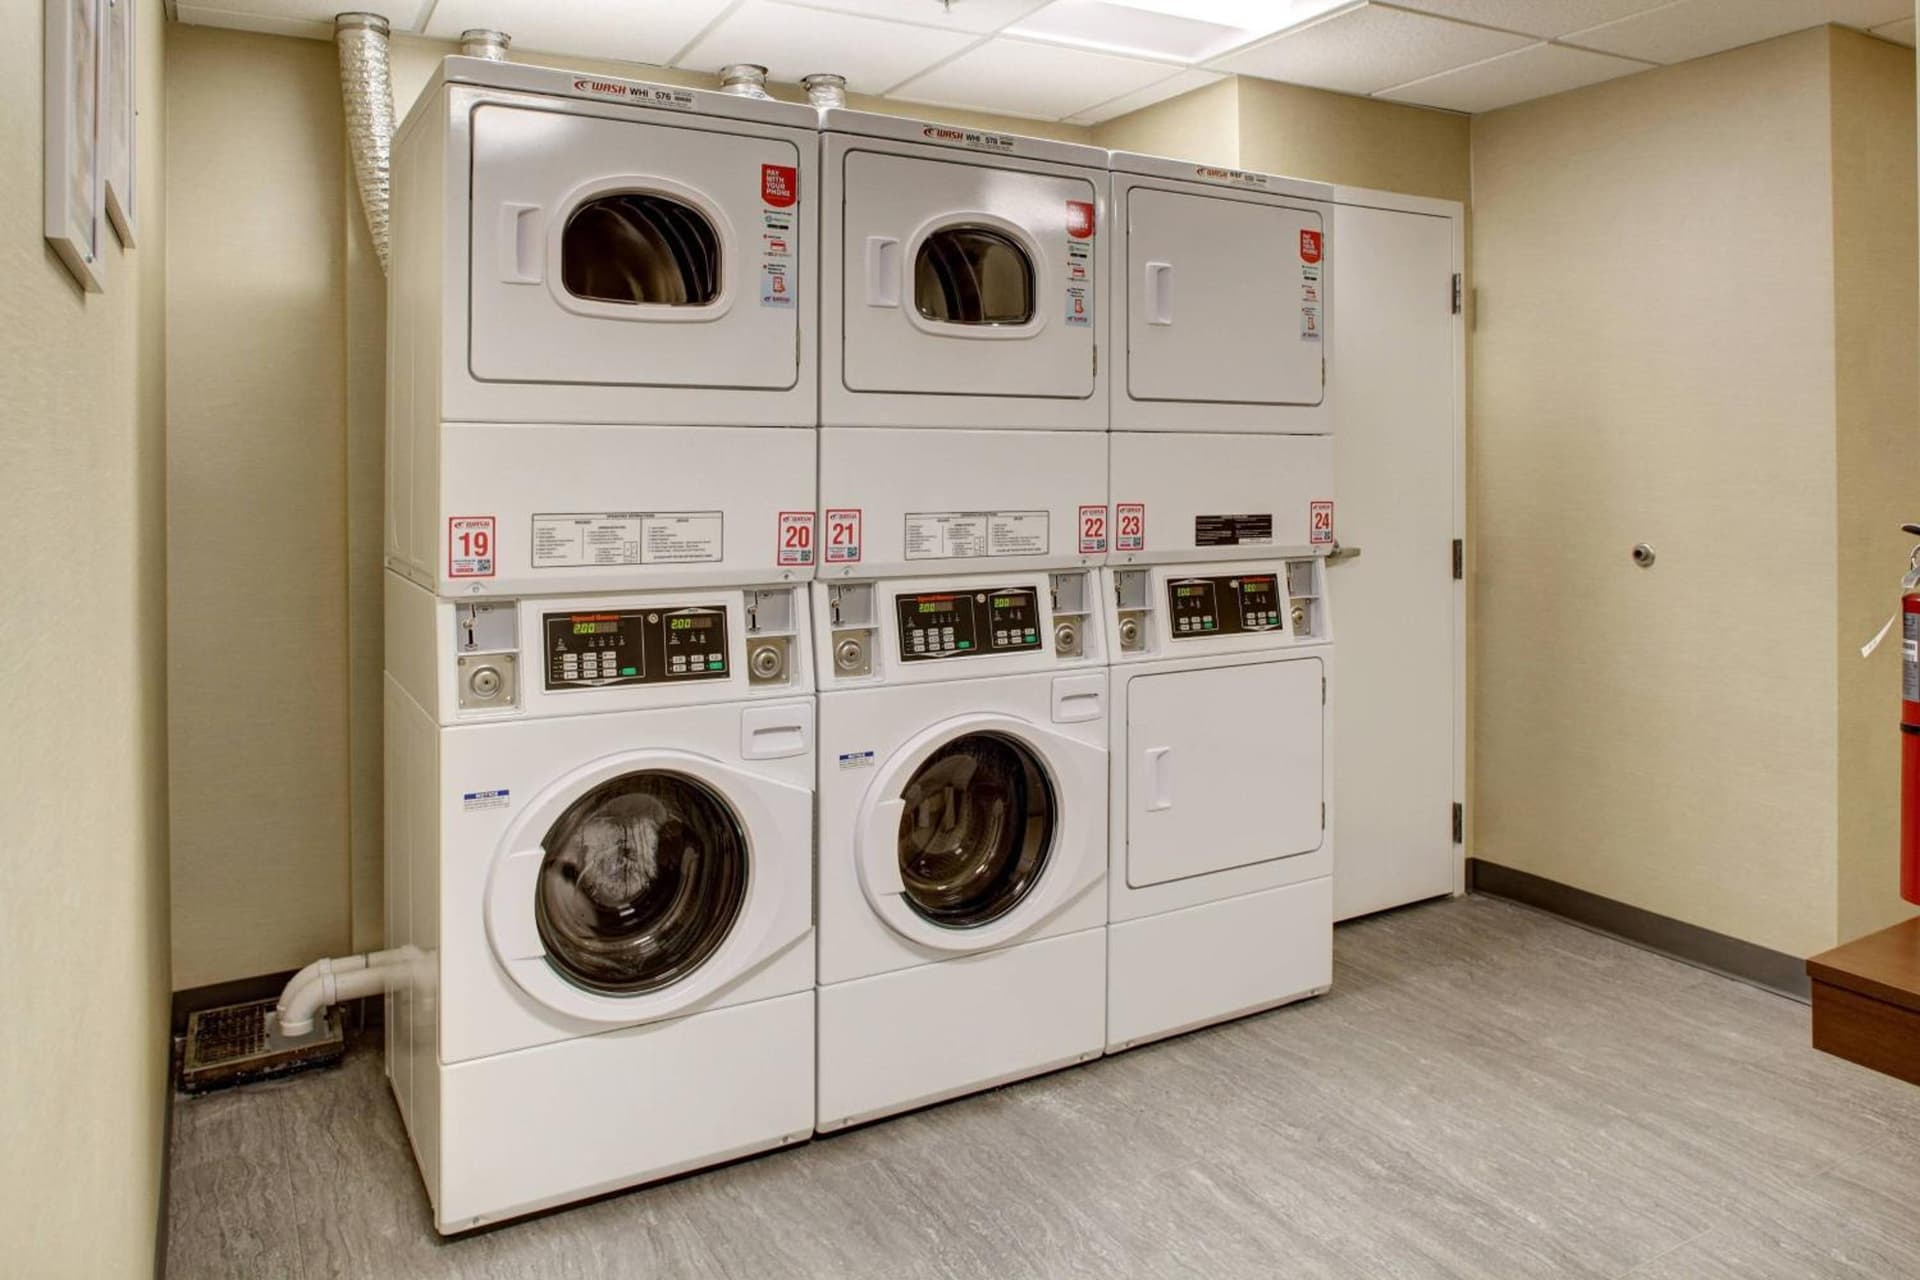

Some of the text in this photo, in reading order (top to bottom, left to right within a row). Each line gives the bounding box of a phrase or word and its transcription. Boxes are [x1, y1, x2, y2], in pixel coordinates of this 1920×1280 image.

[591, 81, 627, 95] WASH
[629, 87, 649, 97] WHI
[1085, 518, 1103, 537] 22
[1122, 516, 1140, 535] 23
[1315, 512, 1329, 529] 24
[785, 526, 810, 548] 20
[833, 523, 853, 544] 21
[458, 531, 489, 557] 19
